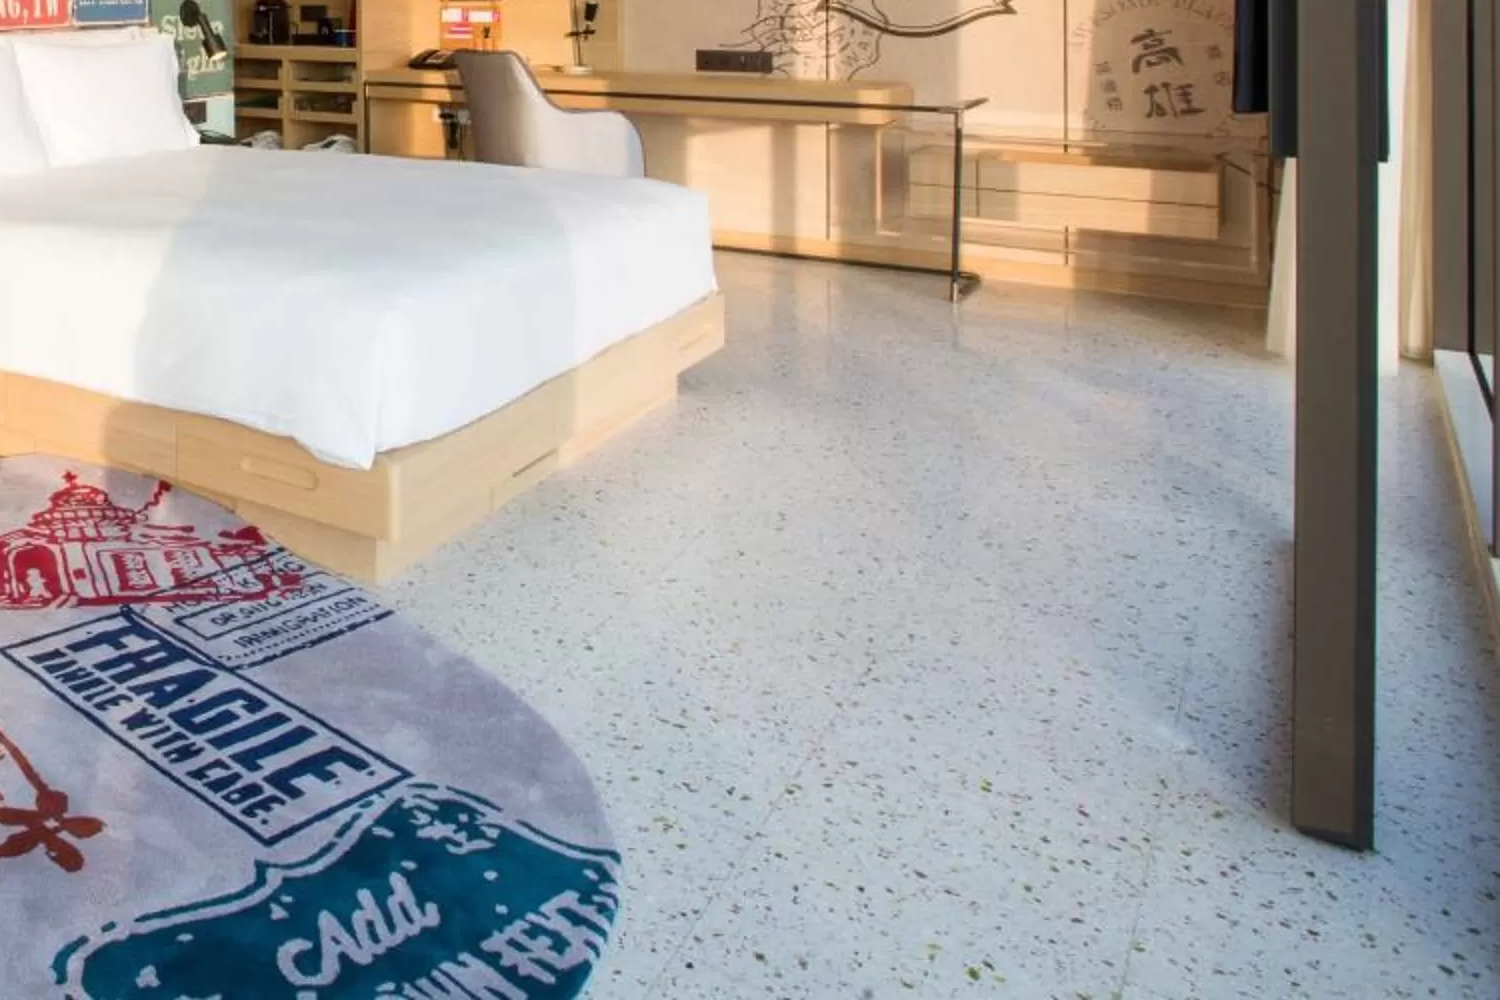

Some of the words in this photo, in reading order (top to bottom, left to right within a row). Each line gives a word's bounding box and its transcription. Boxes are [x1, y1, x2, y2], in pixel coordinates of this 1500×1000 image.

[64, 615, 374, 802] FRAGILE
[119, 707, 206, 764] WITH
[276, 871, 442, 987] Add
